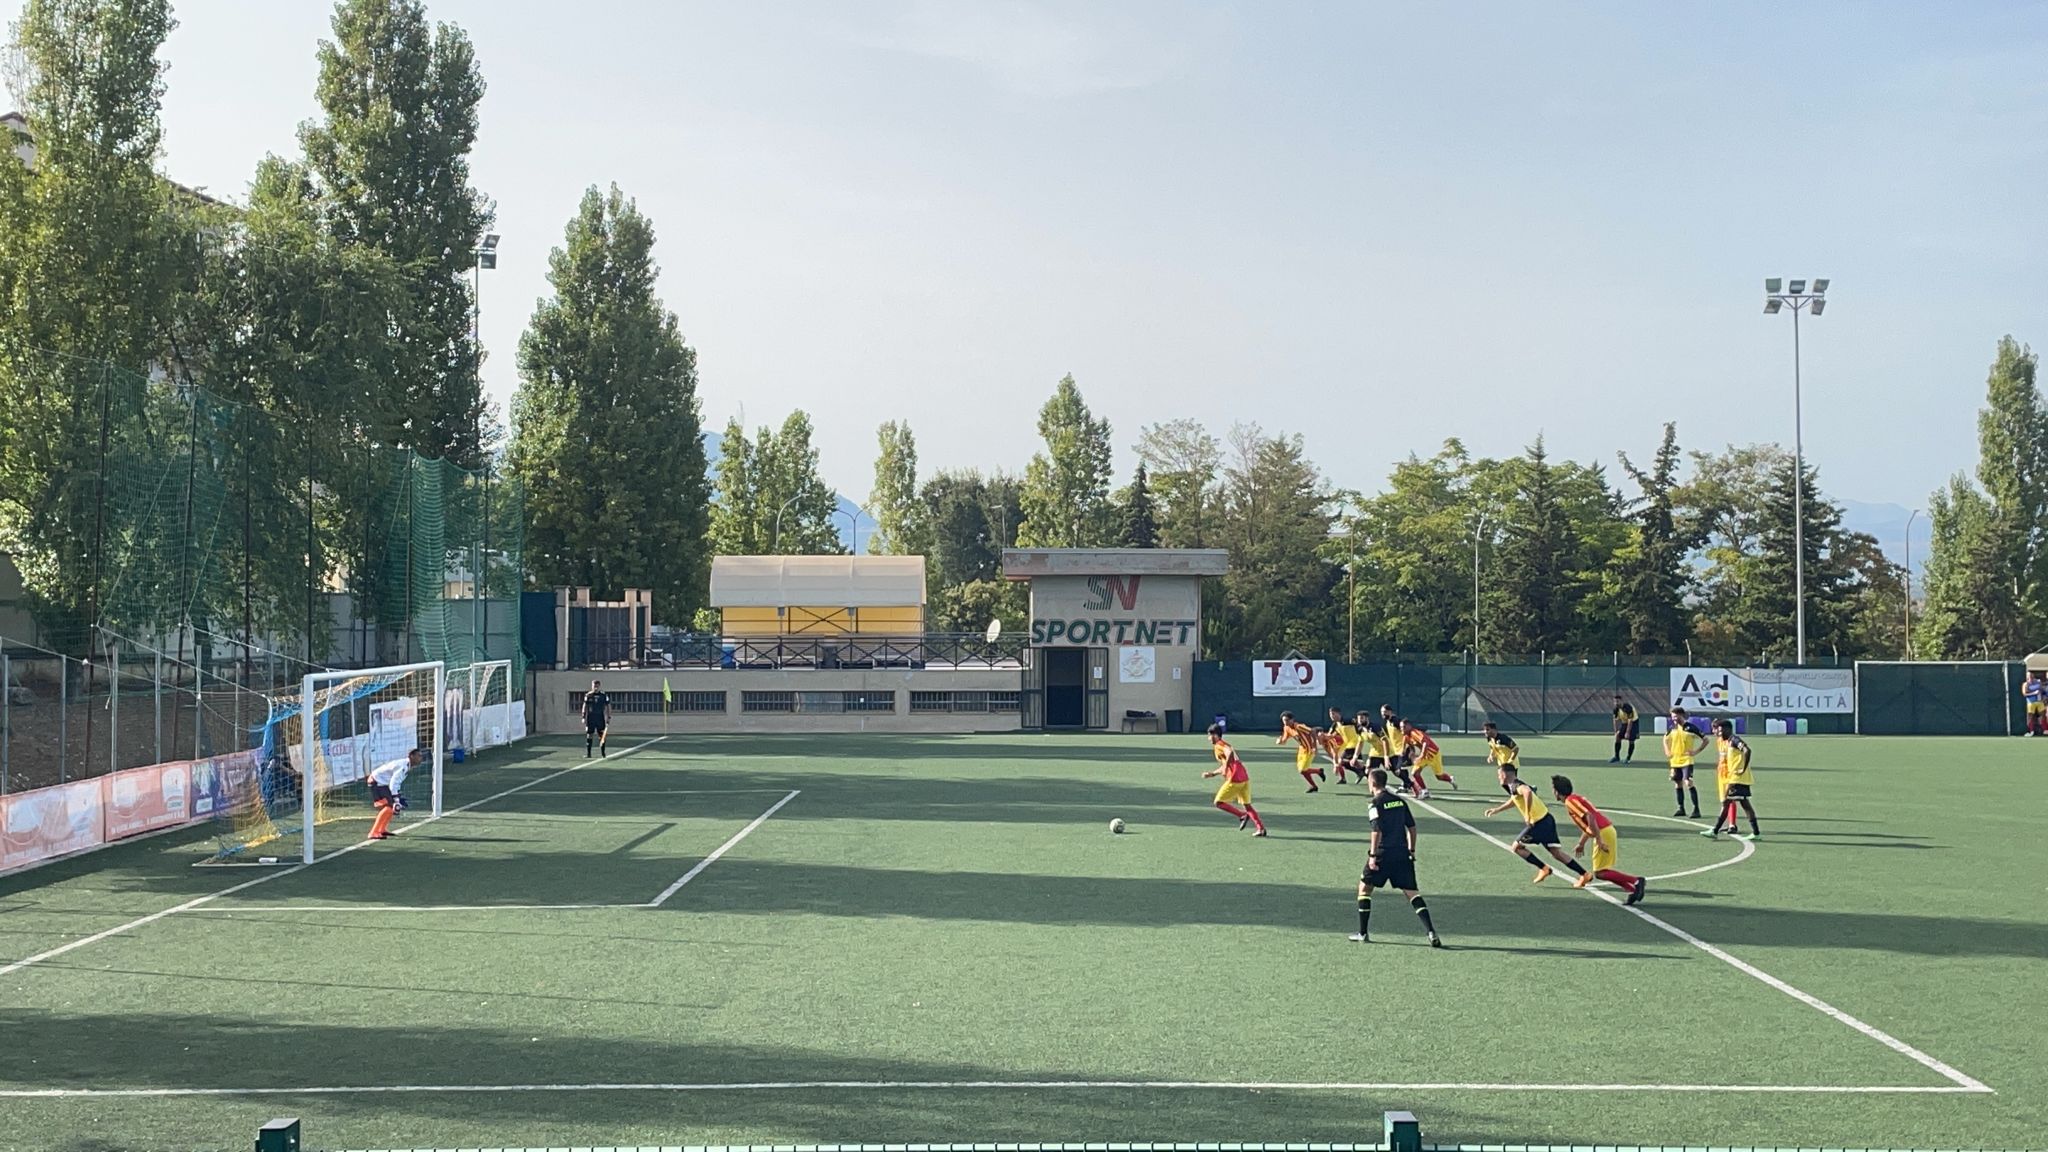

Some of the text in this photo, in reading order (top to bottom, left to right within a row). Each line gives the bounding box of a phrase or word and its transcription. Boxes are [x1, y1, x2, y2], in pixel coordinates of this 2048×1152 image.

[1083, 575, 1142, 611] SN
[1263, 661, 1314, 685] TAO
[1734, 692, 1847, 709] PUBBLICITÀ
